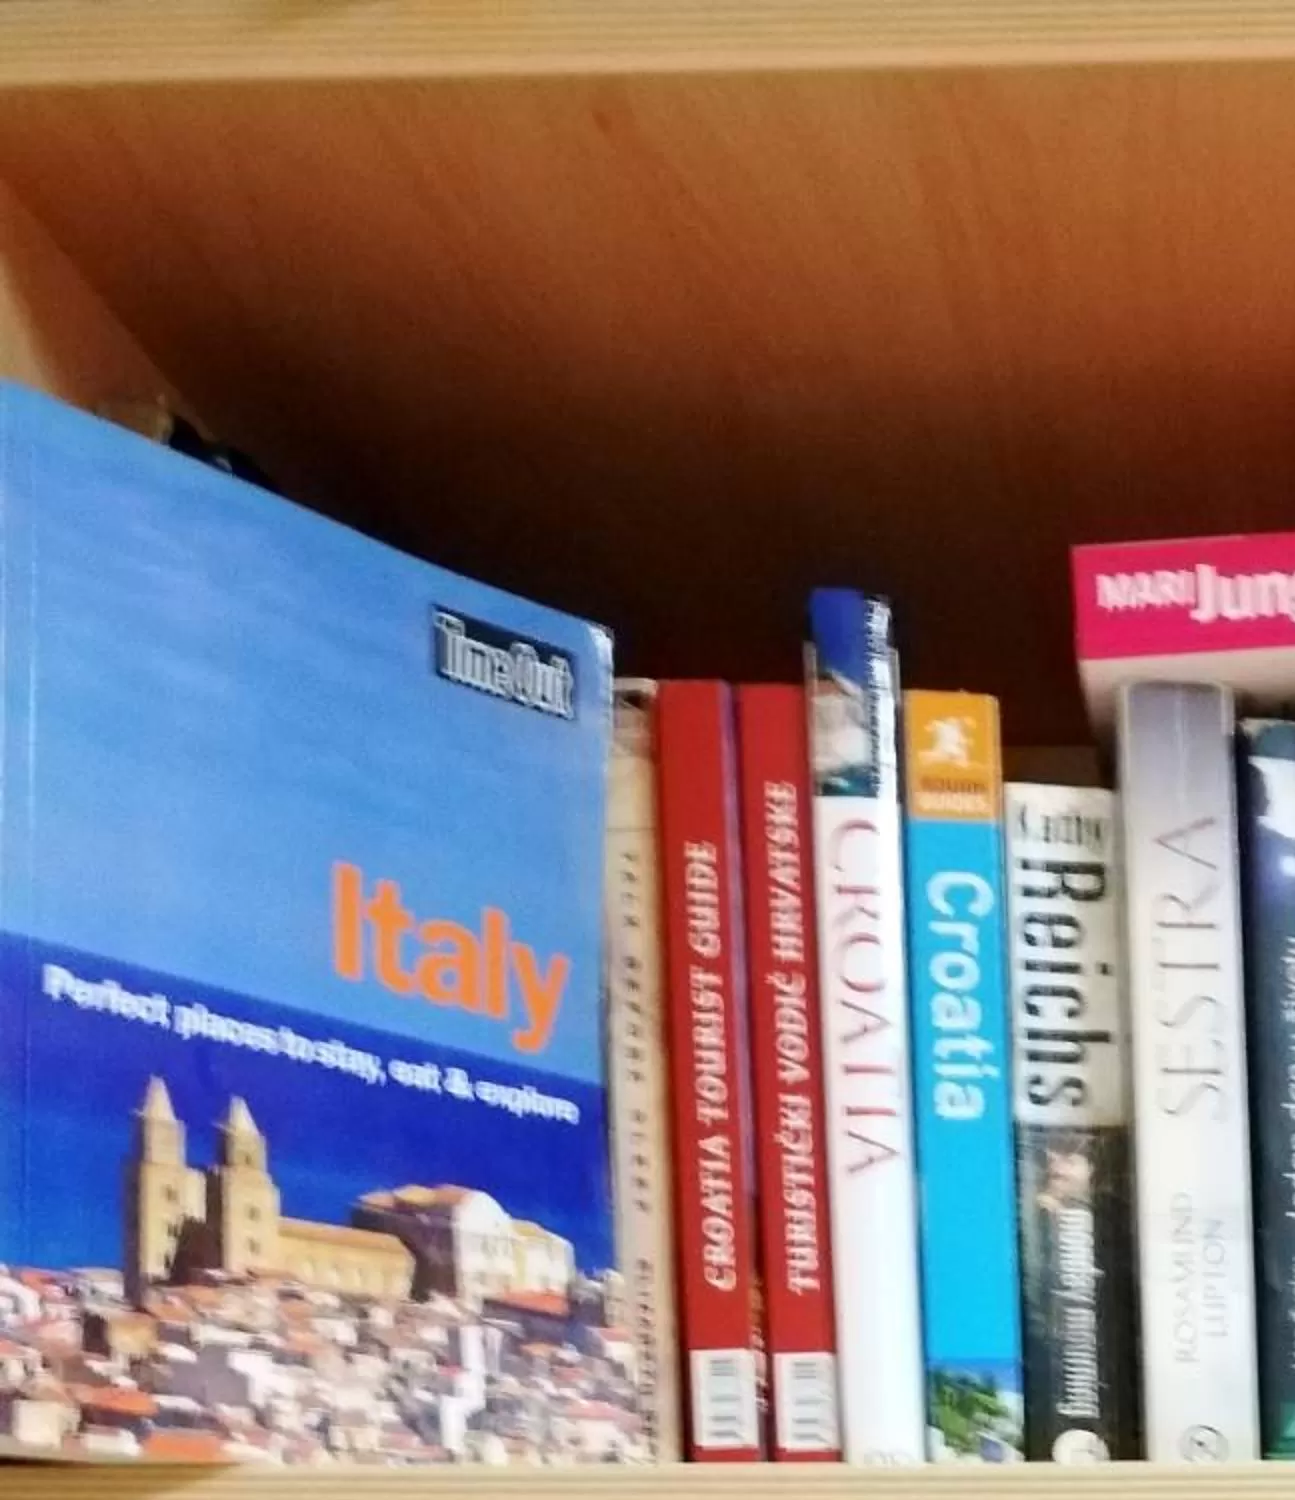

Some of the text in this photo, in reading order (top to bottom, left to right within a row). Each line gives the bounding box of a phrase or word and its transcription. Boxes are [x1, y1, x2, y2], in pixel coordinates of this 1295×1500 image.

[1096, 569, 1195, 612] MARI
[42, 963, 580, 1126] Perfect places to stay, eat & explore
[330, 860, 571, 1055] Italy
[684, 840, 737, 1292] CROATIA TOURIST GUIDE
[763, 780, 821, 1296] TURISTIČKI VODIČ HRVATSKE
[831, 818, 902, 1176] CROATIA
[926, 871, 999, 1121] Croatia
[1020, 859, 1112, 1108] Reichs
[1155, 816, 1227, 1124] SESTRA
[1169, 1191, 1198, 1364] ROSAMUND
[1201, 1216, 1229, 1339] LUPTON
